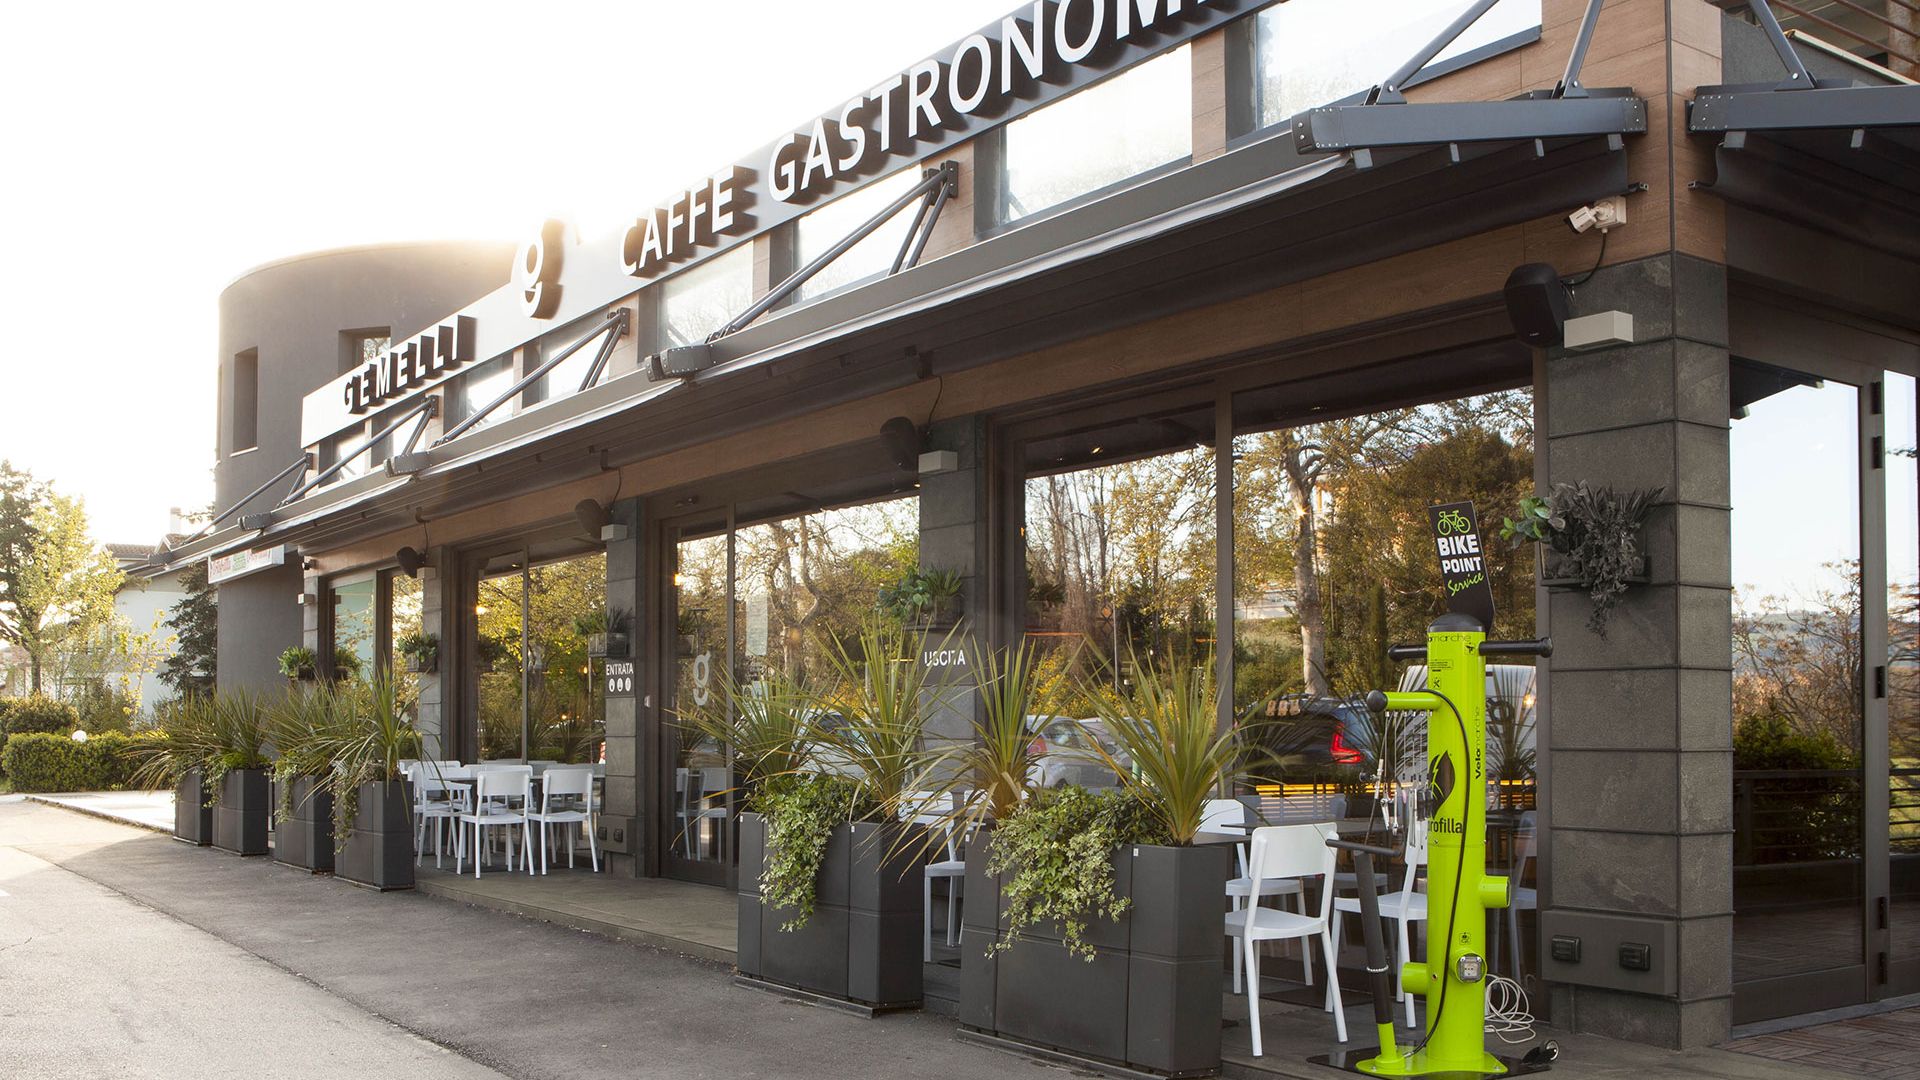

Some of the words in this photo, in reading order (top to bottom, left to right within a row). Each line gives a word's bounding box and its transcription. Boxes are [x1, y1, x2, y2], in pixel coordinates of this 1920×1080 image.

[342, 314, 460, 414] GEMELLI
[620, 165, 735, 276] CAFFE
[768, 0, 1207, 202] GASTRONO
[1437, 534, 1480, 556] BIKE
[1441, 557, 1481, 574] POINT
[1447, 572, 1484, 597] Service
[606, 662, 634, 676] ENTRATA
[1428, 817, 1463, 834] rofilla
